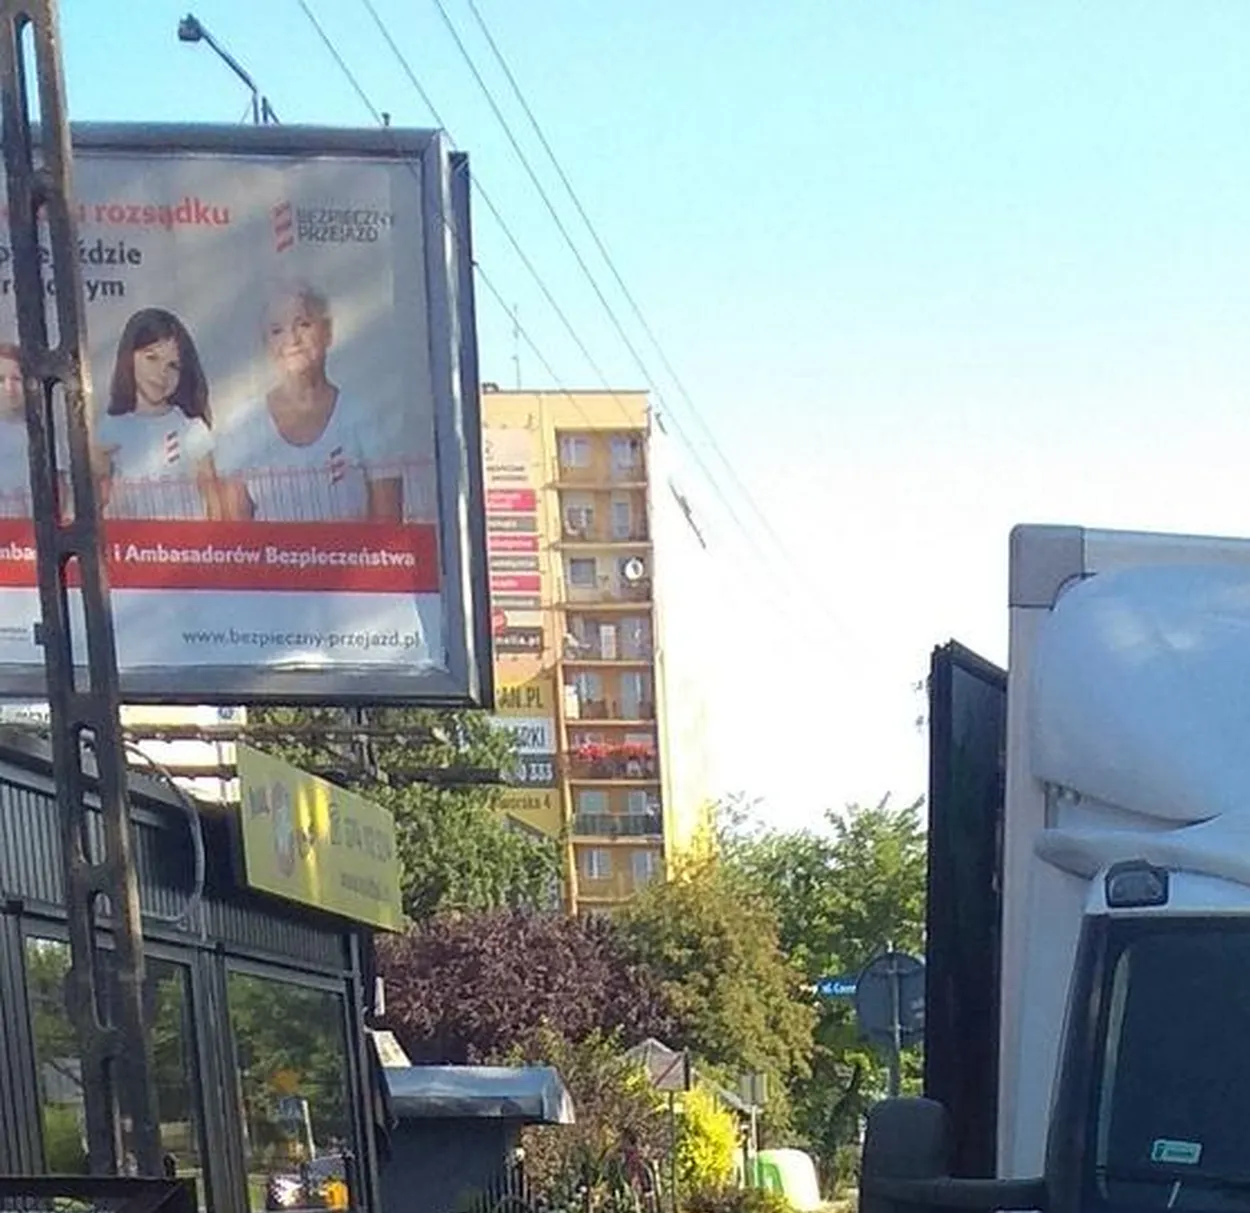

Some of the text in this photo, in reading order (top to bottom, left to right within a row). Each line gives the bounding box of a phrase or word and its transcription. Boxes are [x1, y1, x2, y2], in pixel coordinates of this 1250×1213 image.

[94, 197, 231, 231] rozsądku
[125, 544, 261, 564] Ambasadorów
[265, 546, 416, 567] Bezpieczeństwa
[182, 626, 421, 650] www.bezpieczny-przejazd.pl
